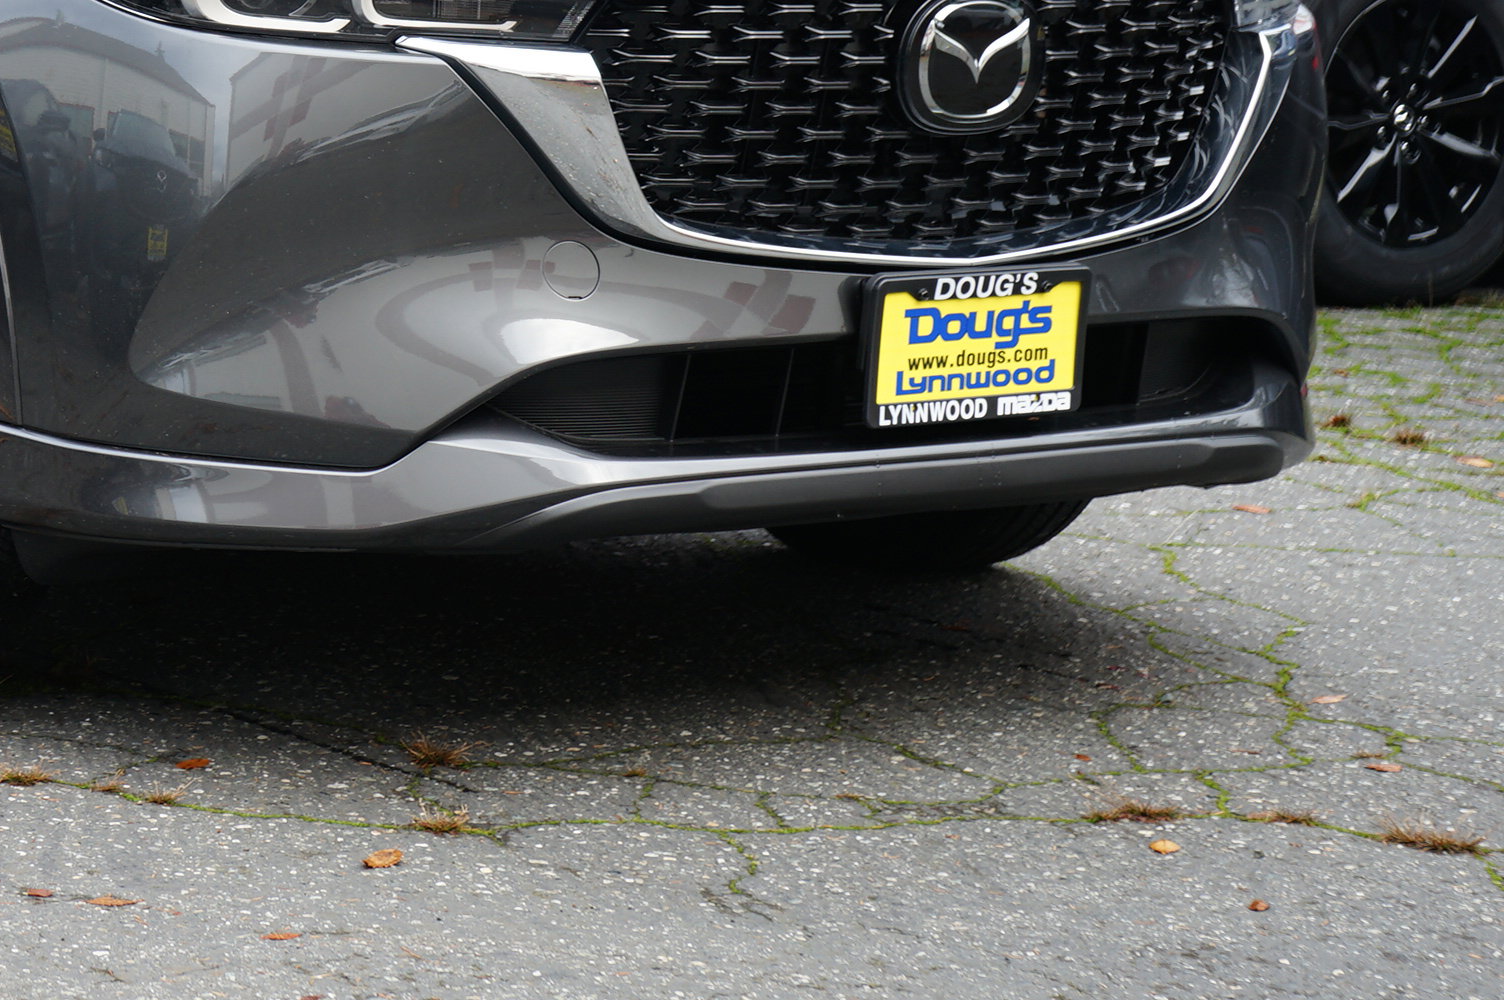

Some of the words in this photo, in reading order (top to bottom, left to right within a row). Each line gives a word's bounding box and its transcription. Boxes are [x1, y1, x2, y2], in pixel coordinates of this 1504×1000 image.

[934, 272, 1039, 300] DOUG'S
[908, 347, 1048, 370] www.dougs.com
[895, 359, 1055, 396] Lynnwood
[879, 398, 988, 426] LYNNWOOD
